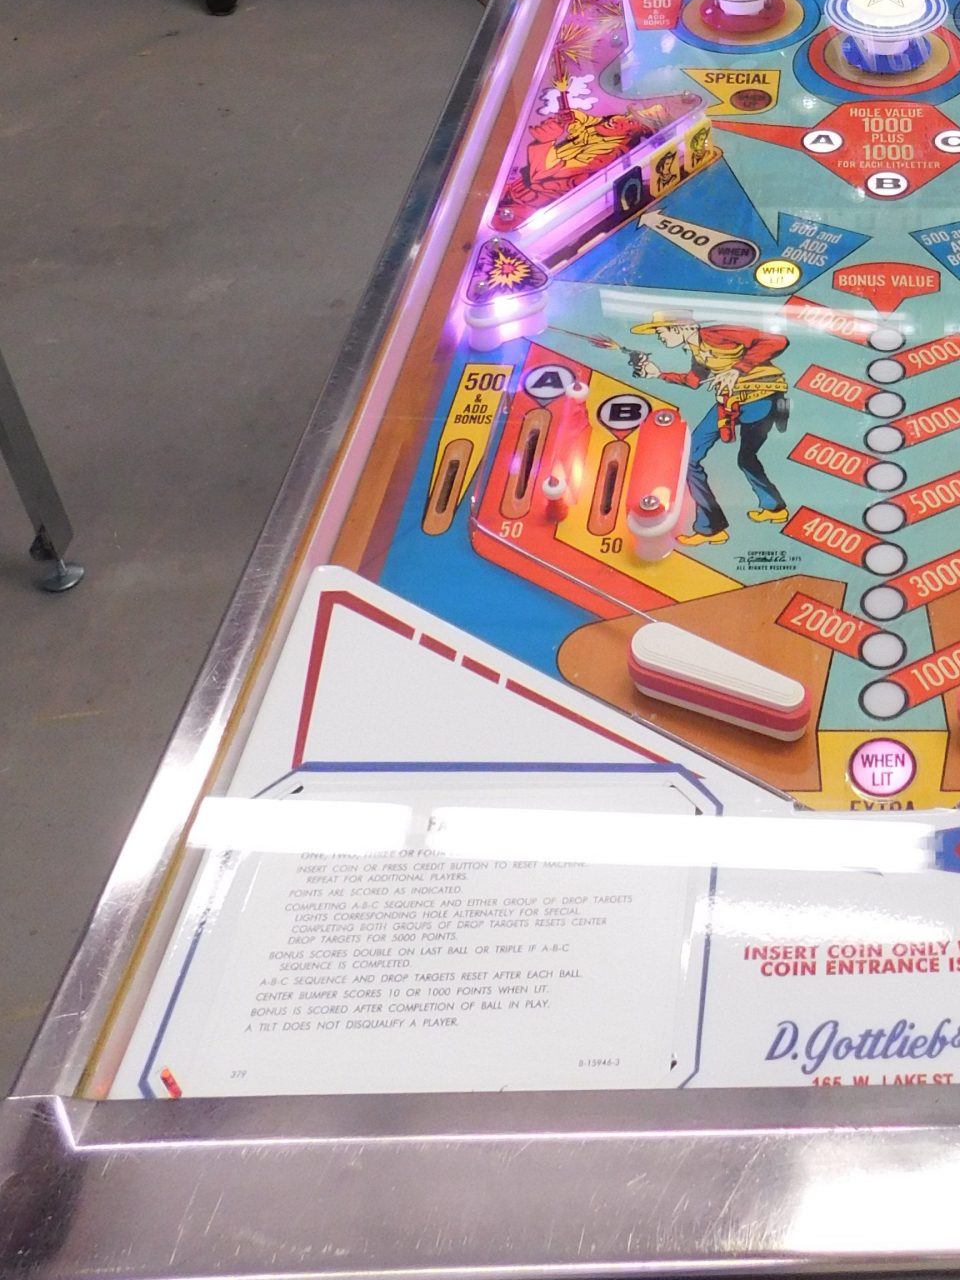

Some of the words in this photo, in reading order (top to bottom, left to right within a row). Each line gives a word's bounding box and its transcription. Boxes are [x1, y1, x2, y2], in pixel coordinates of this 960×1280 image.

[704, 72, 771, 85] SPECIAL
[850, 108, 881, 118] HOLE
[885, 108, 924, 118] VALUE
[863, 117, 912, 133] 1000
[809, 134, 835, 146] A
[871, 133, 904, 144] PLUS
[862, 144, 914, 161] 1000
[837, 160, 856, 169] FOR
[859, 160, 884, 169] EACH
[876, 178, 902, 190] B
[655, 219, 710, 247] 5000
[789, 220, 818, 237] 500
[816, 229, 843, 245] and
[920, 231, 950, 246] 500
[717, 247, 749, 257] WHEN
[800, 239, 828, 254] ADD
[723, 257, 740, 266] LIT
[781, 246, 829, 267] BONUS
[839, 275, 886, 287] BONUS
[891, 276, 935, 288] VALUE
[908, 342, 960, 369] 9000
[465, 373, 507, 391] 500
[530, 371, 564, 389] A
[809, 372, 863, 402] 8000
[474, 394, 482, 403] &
[463, 404, 488, 414] ADD
[608, 403, 642, 421] B
[454, 415, 492, 424] BONUS
[804, 443, 861, 475] 6000
[500, 522, 524, 538] 50
[802, 517, 862, 554] 4000
[600, 537, 623, 554] 50
[790, 603, 857, 644] 2000
[861, 753, 906, 768] WHEN
[871, 771, 894, 787] LIT
[743, 944, 819, 961] INSERT
[827, 944, 883, 960] COIN
[892, 941, 950, 958] ONLY
[760, 960, 817, 977] COIN
[826, 957, 940, 976] ENTRANCE
[244, 1023, 252, 1032] A
[259, 1022, 277, 1031] TILT
[283, 1022, 311, 1031] DOES
[317, 1021, 340, 1030] NOT
[346, 1019, 405, 1029] DISQUALIFY
[409, 1018, 417, 1027] A
